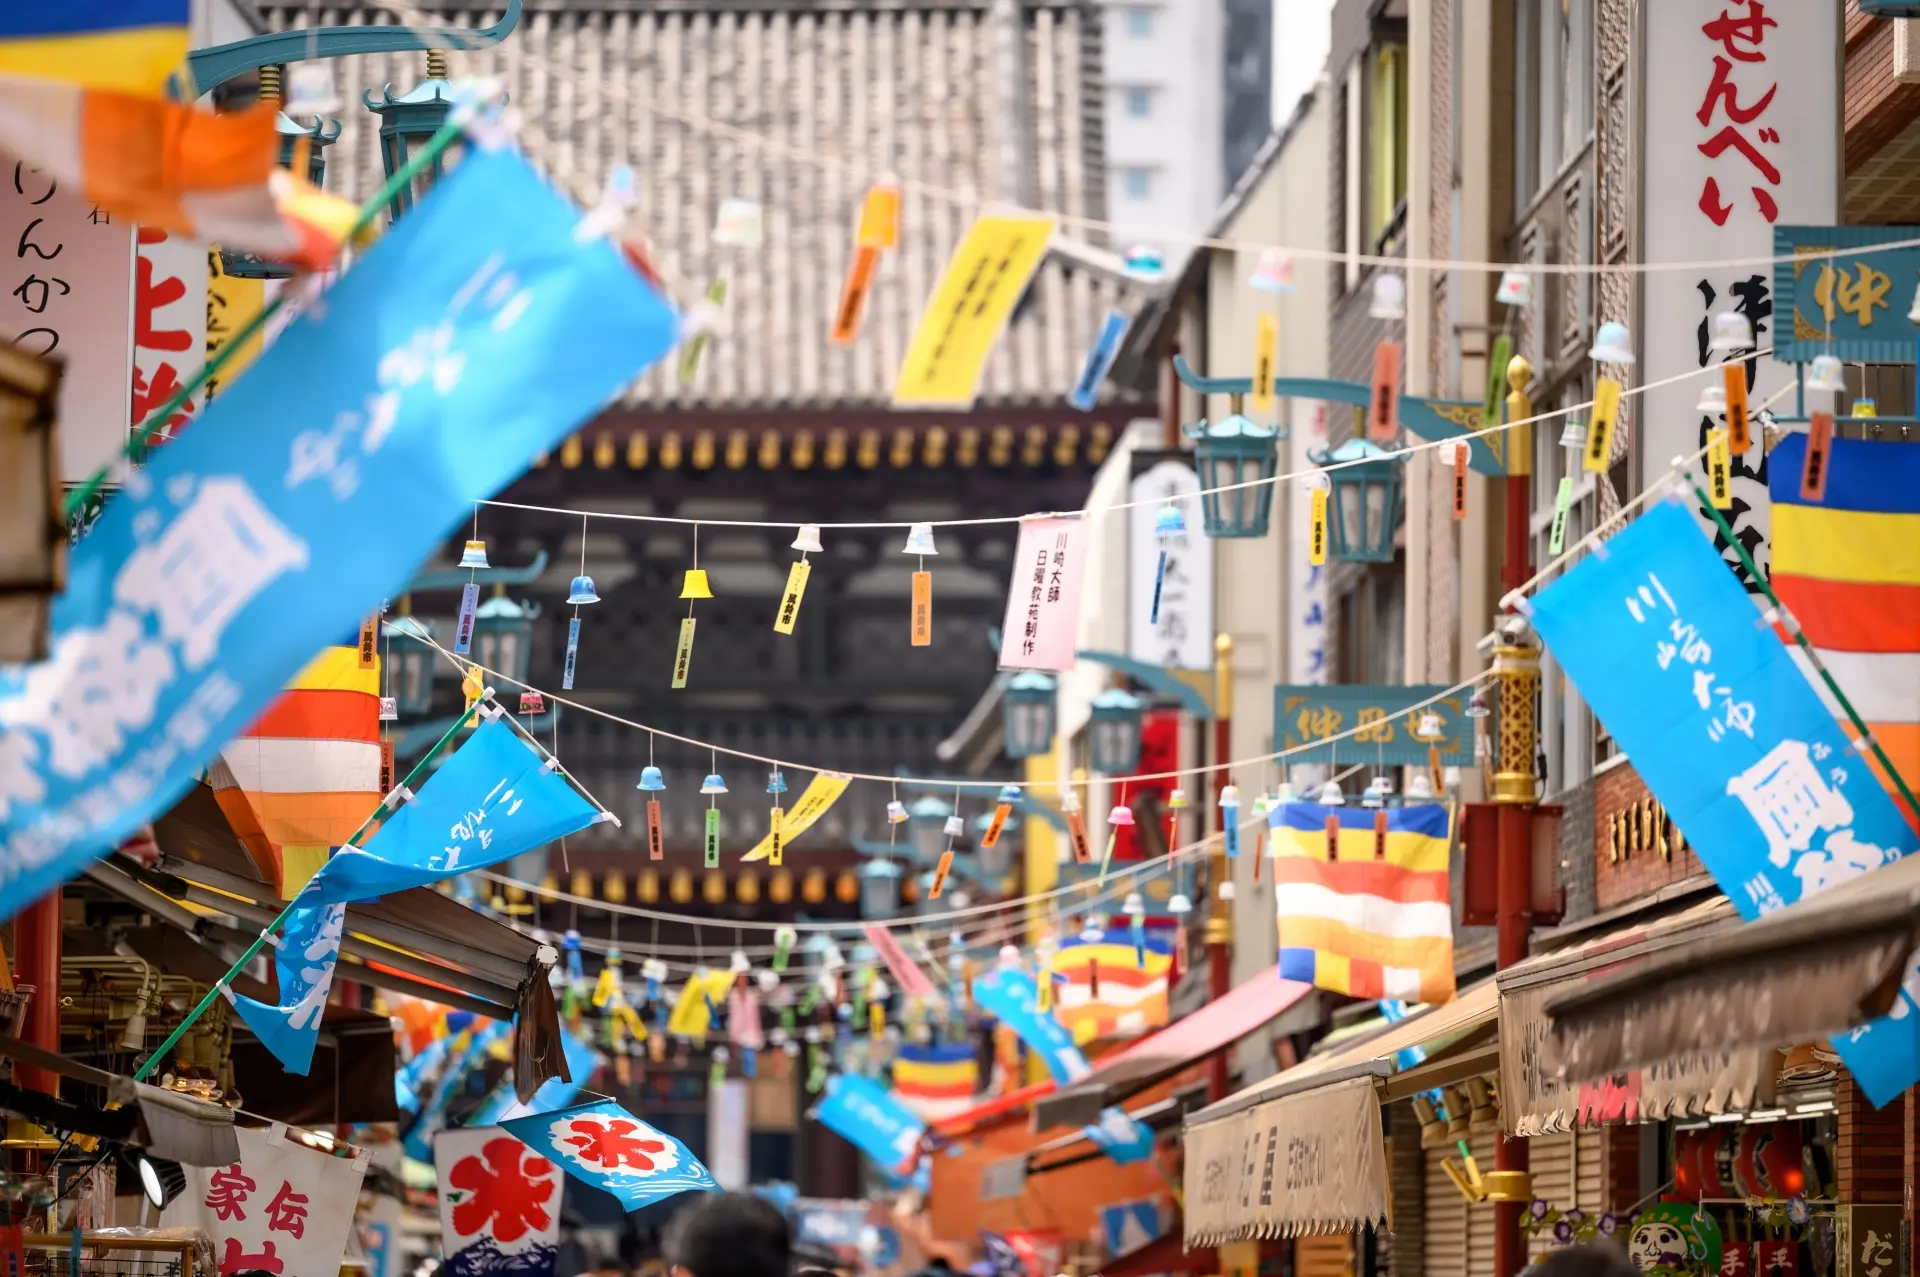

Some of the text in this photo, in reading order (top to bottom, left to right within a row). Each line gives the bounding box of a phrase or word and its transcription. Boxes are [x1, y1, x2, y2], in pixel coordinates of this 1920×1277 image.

[1696, 0, 1781, 226] せんべい
[1813, 261, 1893, 327] 仲
[1047, 533, 1068, 603] 川崎大師
[1022, 550, 1047, 656] 日曜教苑制作
[362, 631, 373, 663] 風鈴市
[381, 766, 390, 794] 風鈴市
[205, 1163, 309, 1239] 家伝
[1861, 1229, 1893, 1277] だ
